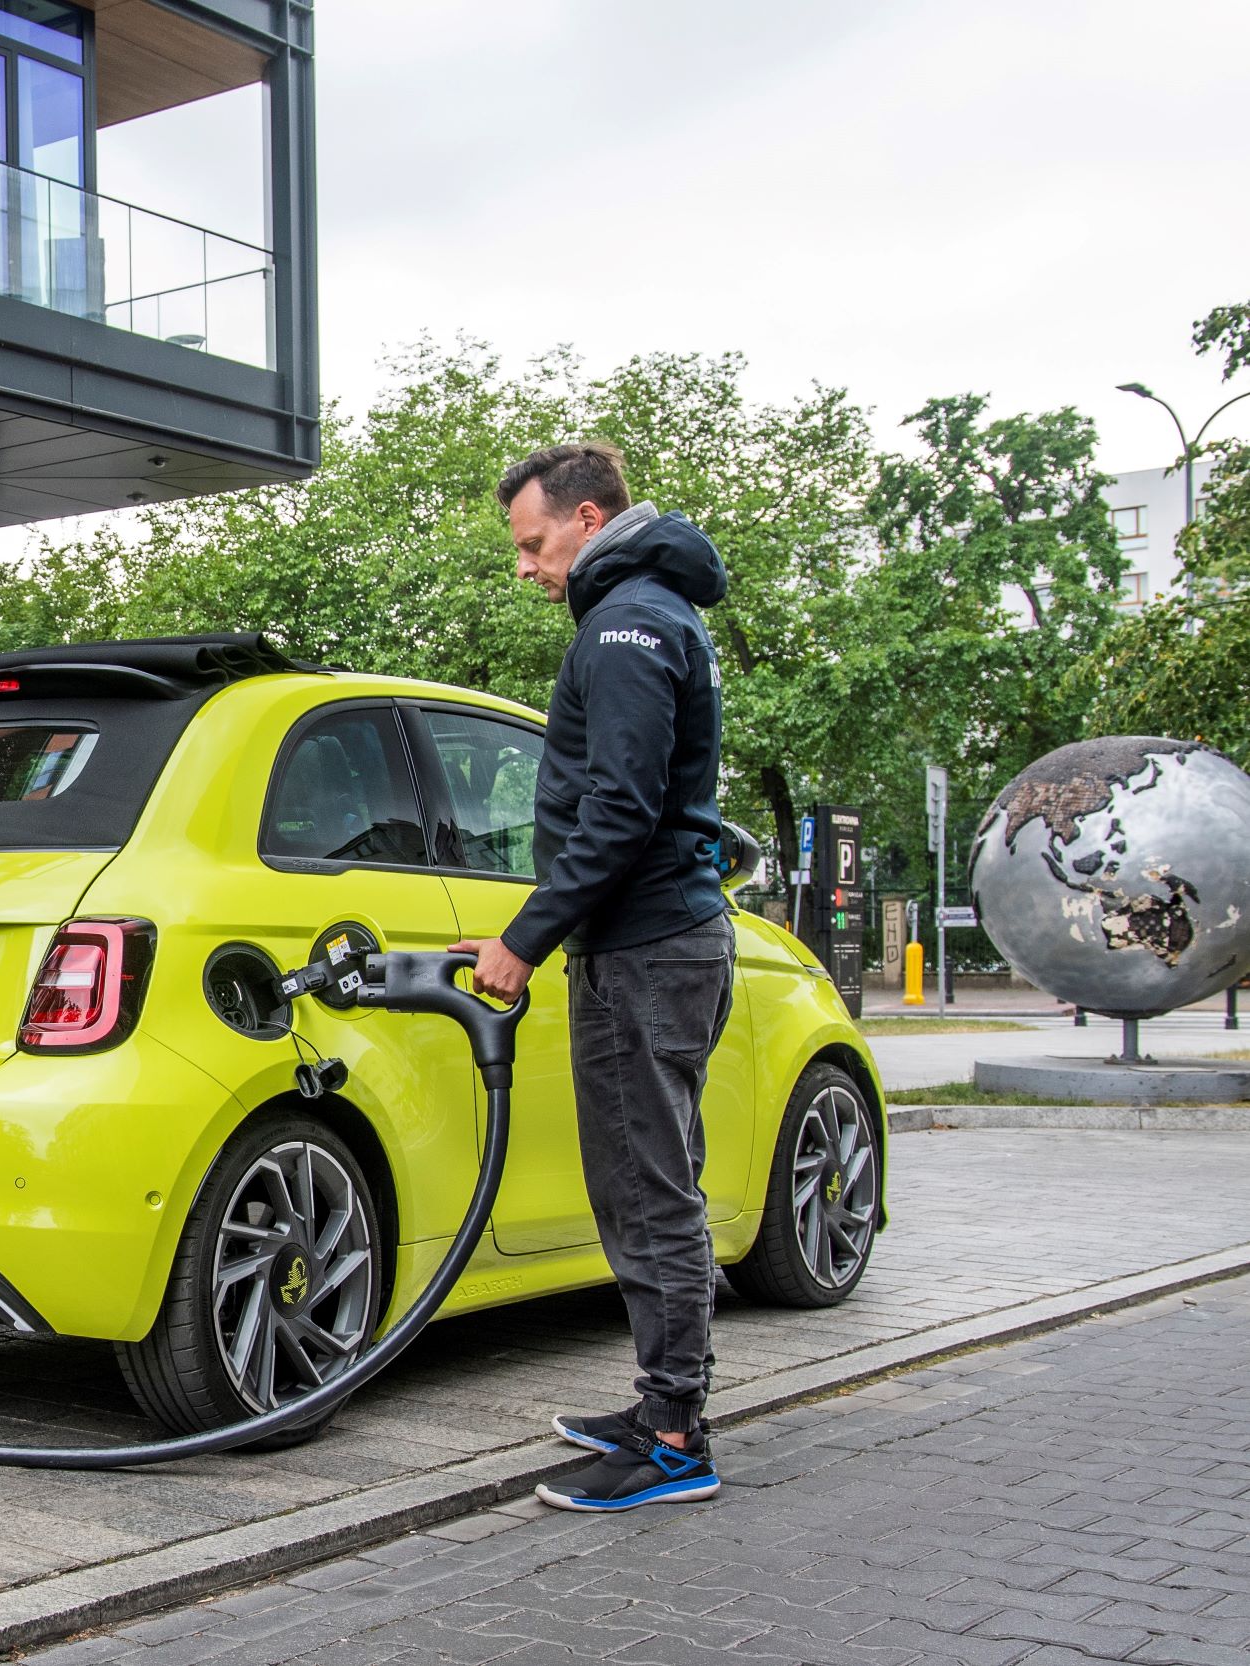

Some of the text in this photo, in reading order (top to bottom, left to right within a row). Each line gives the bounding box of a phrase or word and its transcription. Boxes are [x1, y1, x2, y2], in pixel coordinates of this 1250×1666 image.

[599, 629, 661, 650] motor
[803, 822, 812, 848] P
[840, 843, 852, 879] P
[455, 1275, 523, 1299] ABARTH
